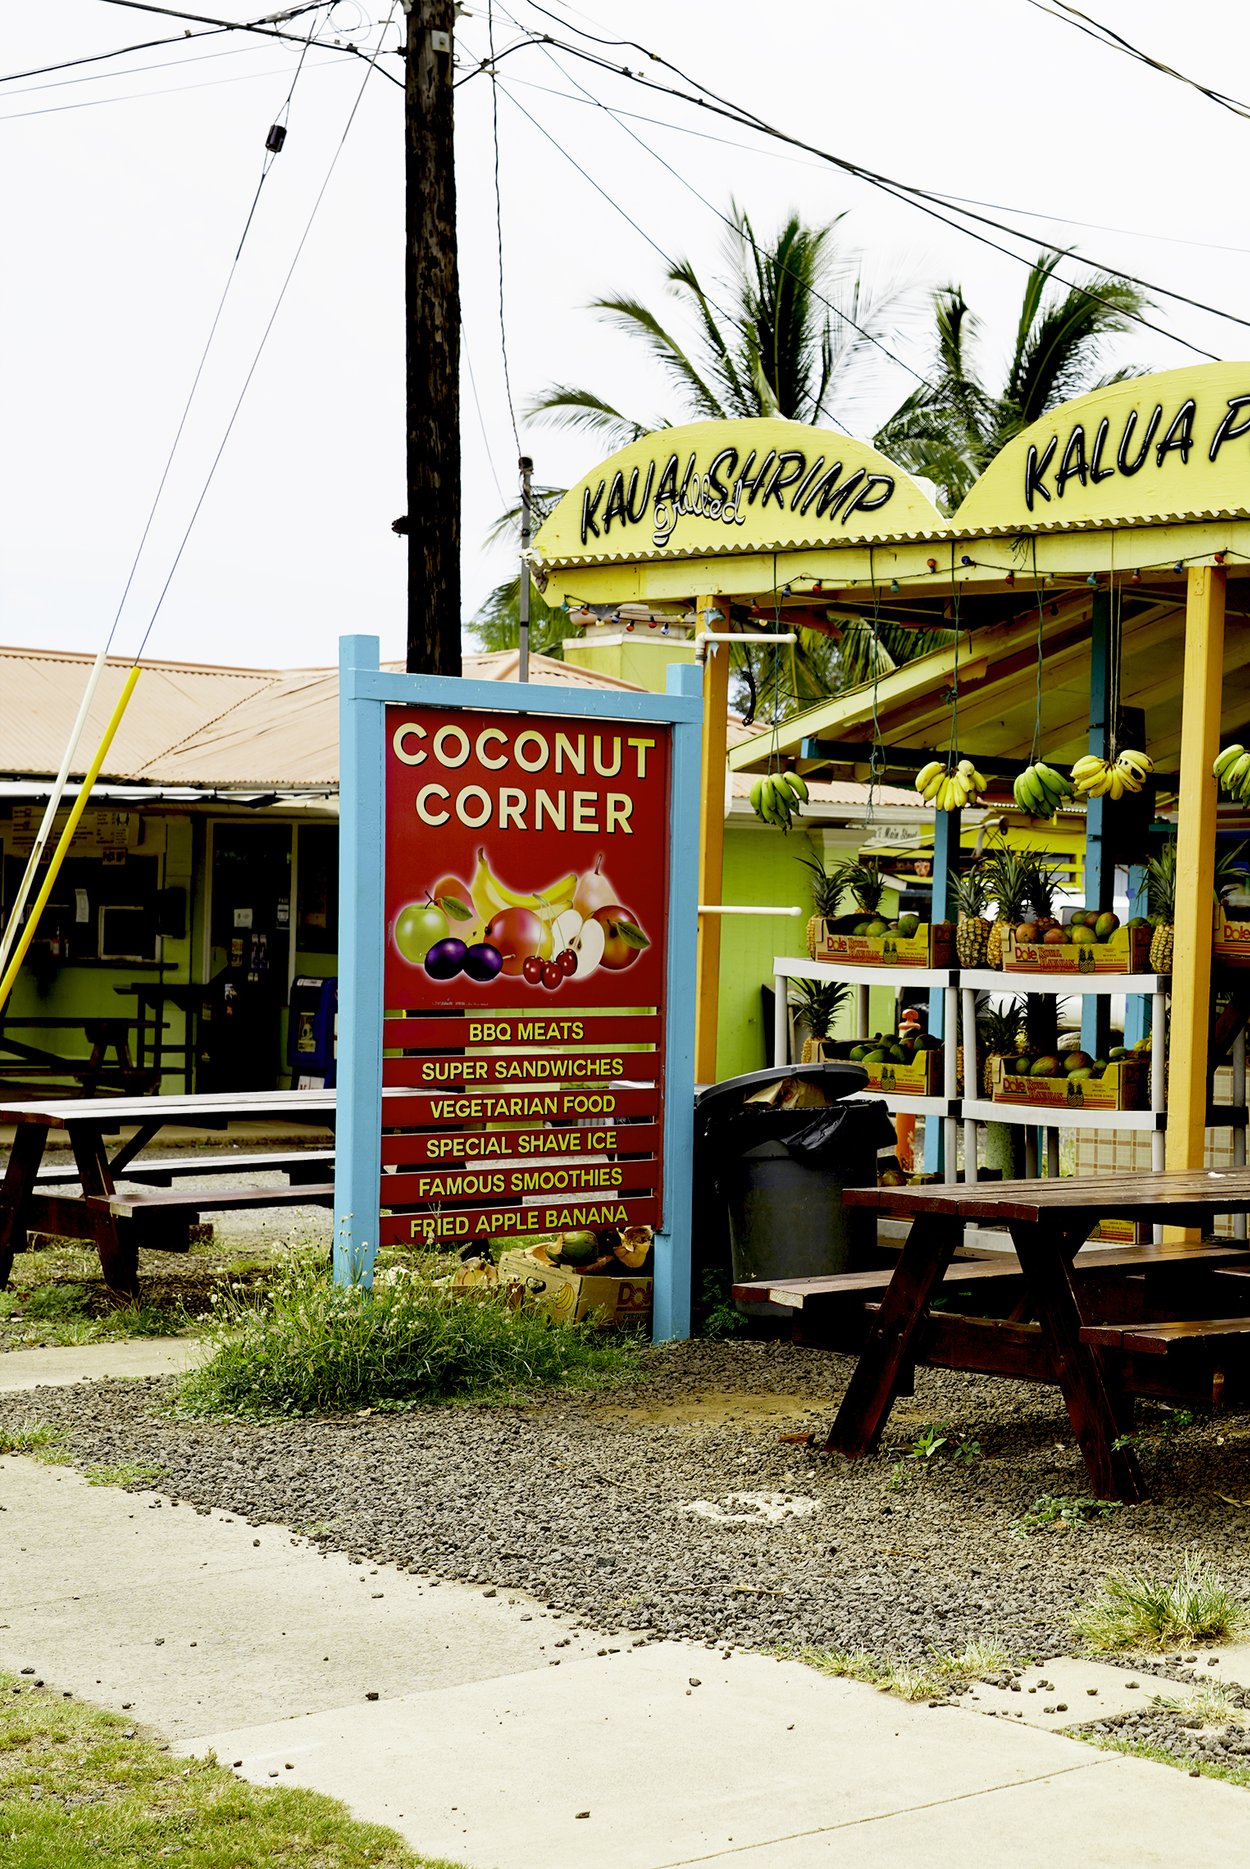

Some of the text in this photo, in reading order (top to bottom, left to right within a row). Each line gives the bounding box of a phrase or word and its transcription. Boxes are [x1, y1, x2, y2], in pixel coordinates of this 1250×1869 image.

[1025, 399, 1196, 511] KALUA
[580, 447, 895, 545] KAUAI SHRIMP
[652, 472, 746, 547] grilled
[393, 722, 656, 779] COCONUT
[415, 783, 634, 834] CORNER
[827, 937, 847, 950] Dole
[1224, 925, 1250, 940] Dole
[1015, 947, 1038, 960] Dole
[469, 1022, 584, 1042] BBQ MEATS
[422, 1058, 624, 1081] SUPER SANDWICHES
[1003, 1078, 1026, 1092] Dole
[430, 1095, 616, 1118] VEGETARIAN FOOD
[426, 1132, 617, 1158] SPECIAL SHAVE ICE
[419, 1167, 623, 1197] FAMOUS SMOOTHIES
[410, 1205, 629, 1238] FRIED APPLE BANANA
[617, 1281, 652, 1306] Dol
